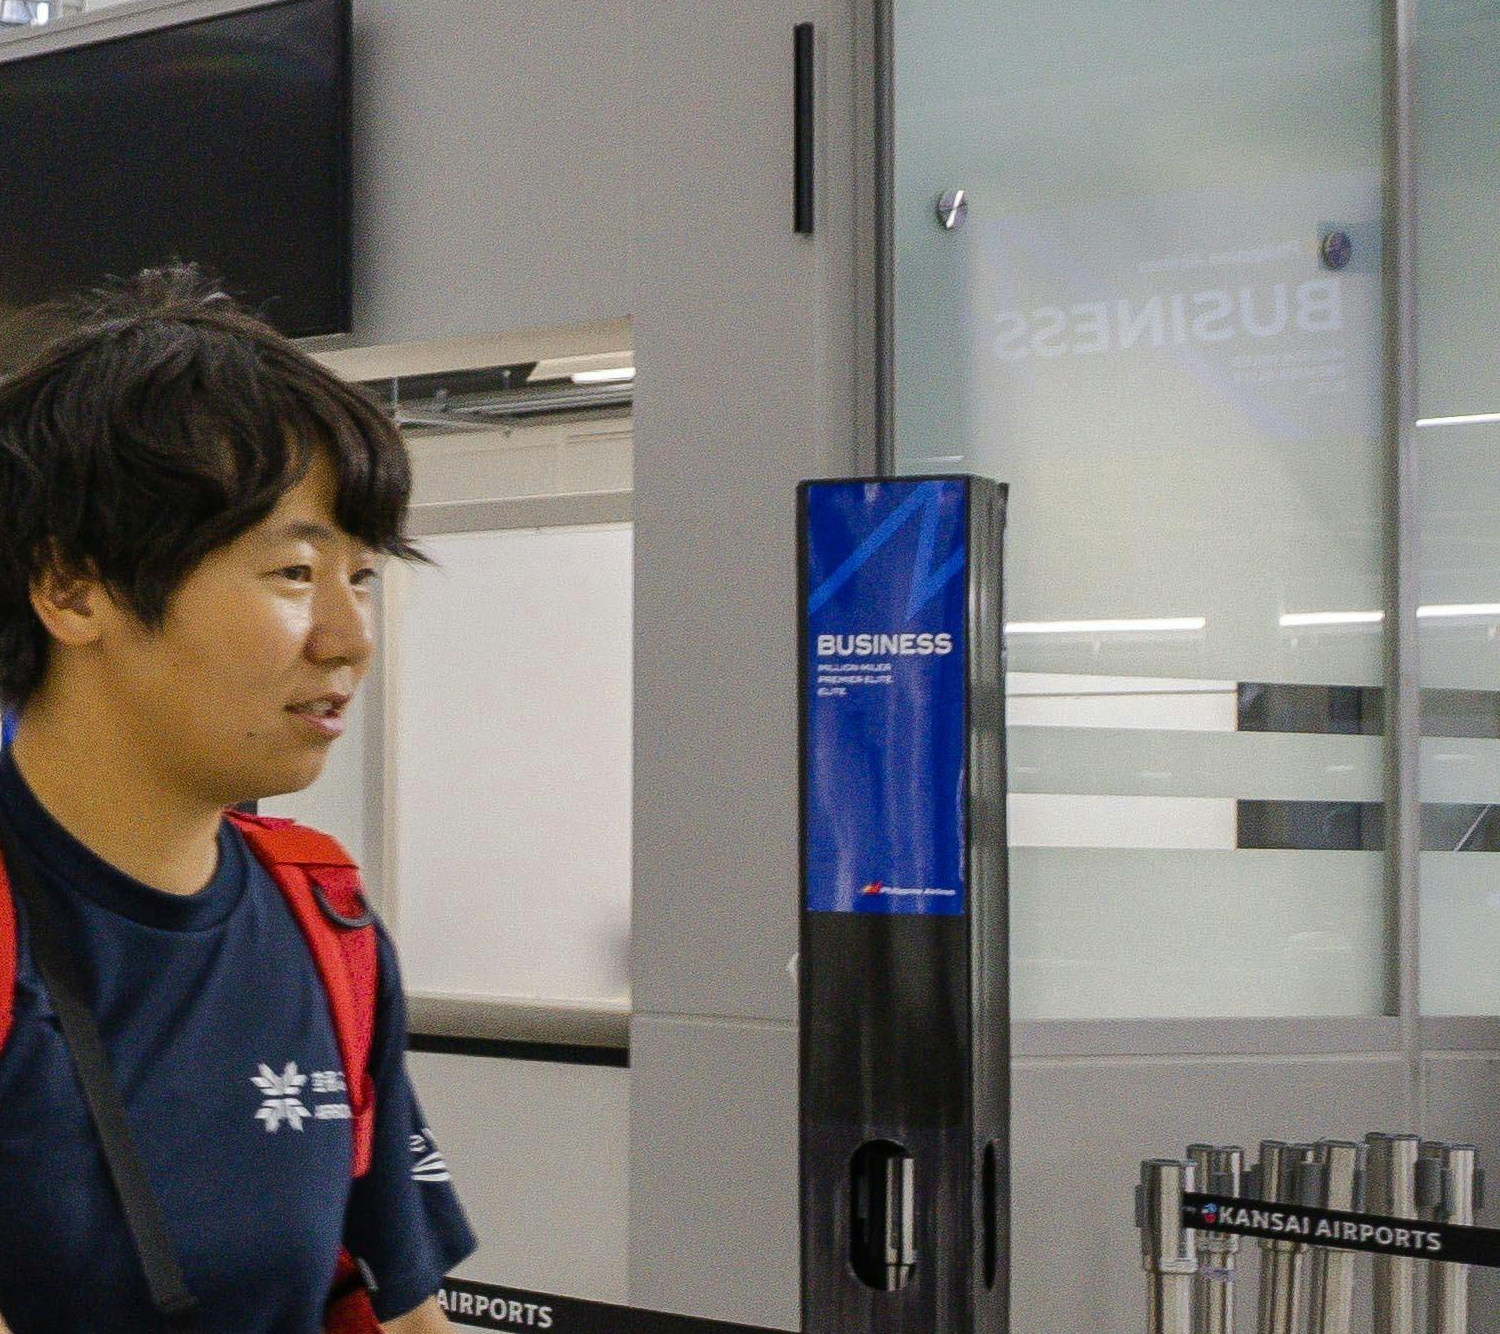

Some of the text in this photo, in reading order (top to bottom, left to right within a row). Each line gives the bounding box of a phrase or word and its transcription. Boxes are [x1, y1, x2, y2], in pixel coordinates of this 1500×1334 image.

[817, 633, 953, 657] BUSINESS
[1218, 1206, 1443, 1251] KANSAI AIRPORTS
[437, 1287, 554, 1329] AIRPORTS
